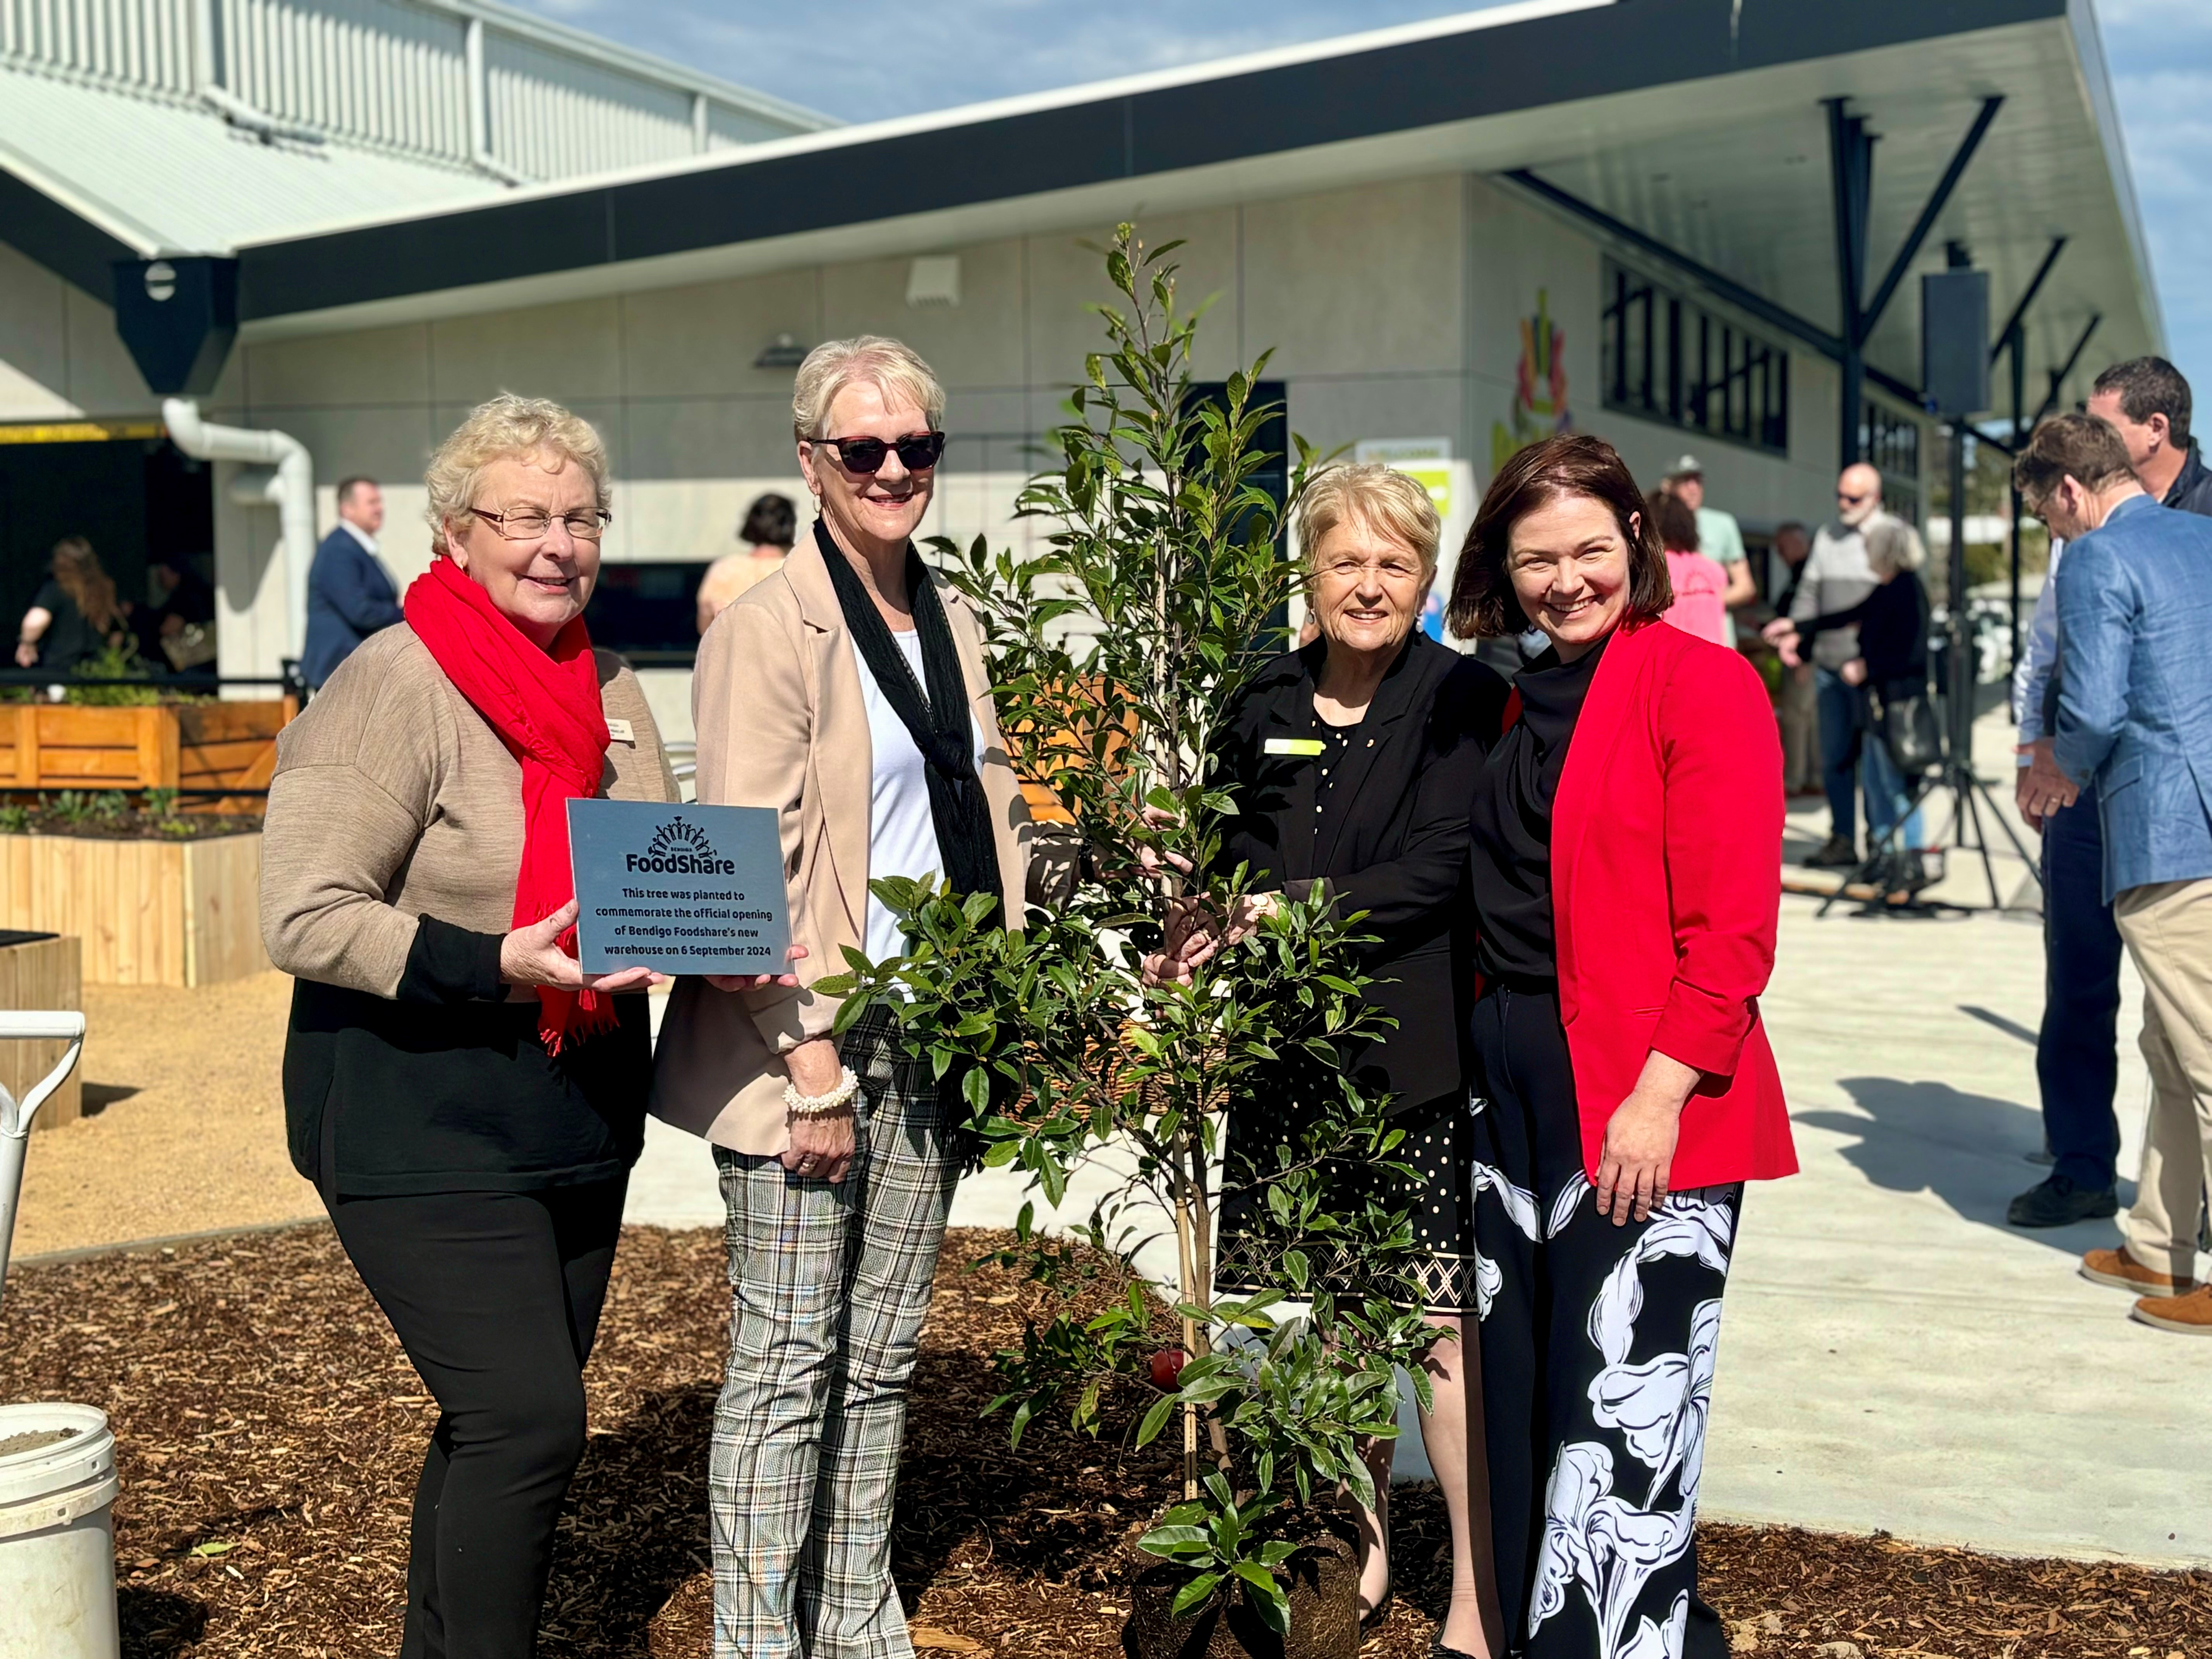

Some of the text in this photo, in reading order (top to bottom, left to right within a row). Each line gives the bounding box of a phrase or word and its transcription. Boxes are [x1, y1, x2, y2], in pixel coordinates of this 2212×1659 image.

[626, 854, 735, 875] FoodShare
[622, 888, 745, 902] This tree was planted to
[595, 907, 772, 922] commemorate the official opening
[614, 925, 759, 938] of Bendigo Foodshare's new
[604, 944, 771, 958] warehouse on 6 September 2024
